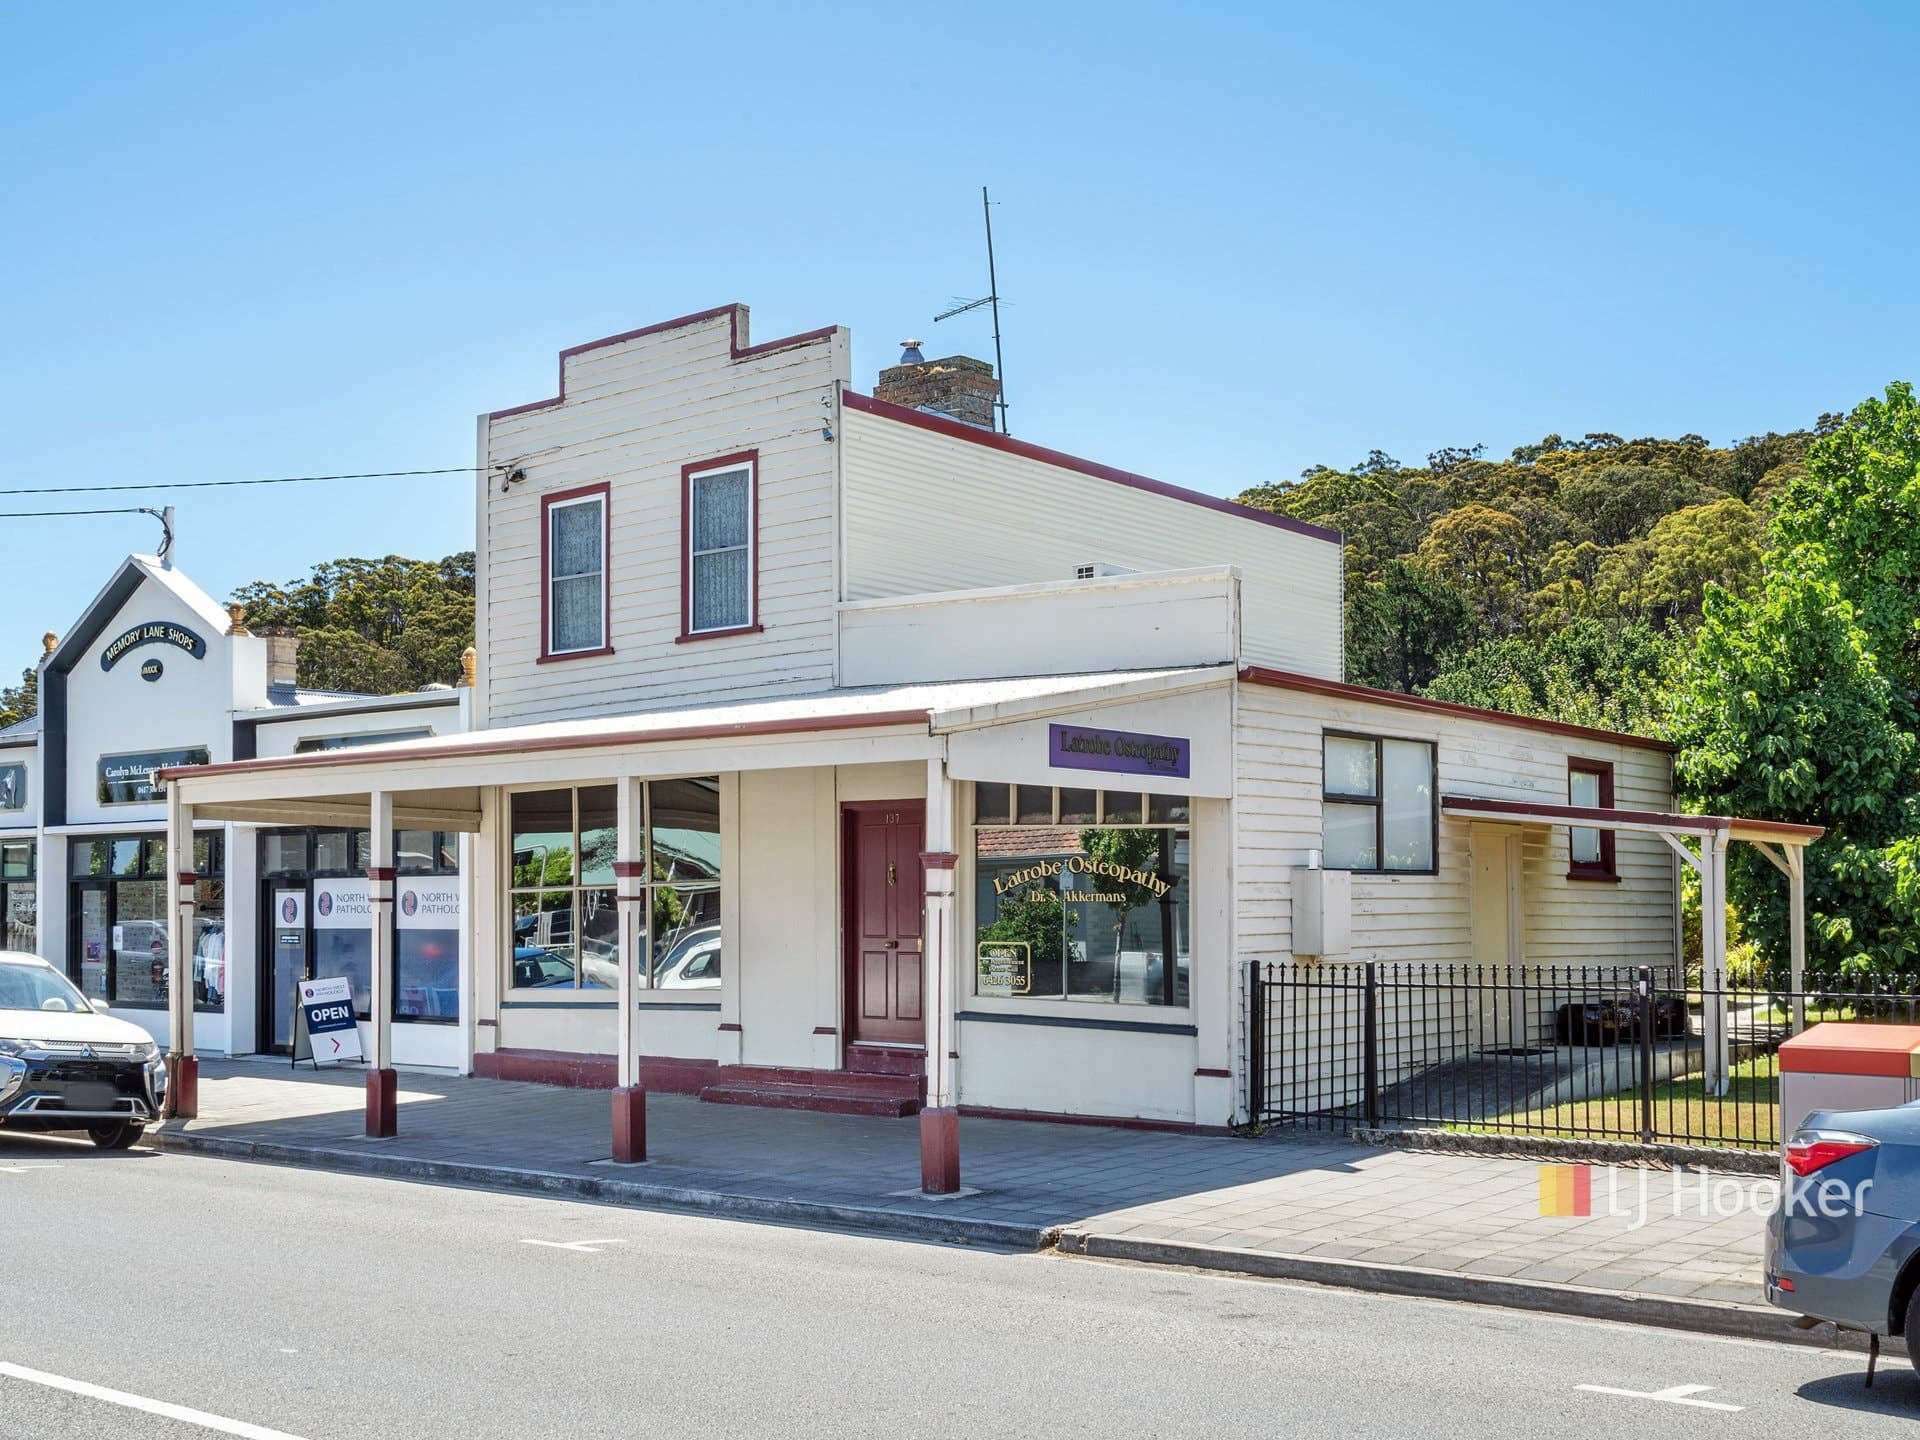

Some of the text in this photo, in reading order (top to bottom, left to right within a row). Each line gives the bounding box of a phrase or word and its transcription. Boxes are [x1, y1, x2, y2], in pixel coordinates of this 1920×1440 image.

[106, 626, 194, 661] MEMORY LANE SHOPS
[1060, 731, 1179, 766] Latrobe Osteopathy
[105, 765, 129, 779] Carolyn
[886, 813, 900, 824] 137
[993, 856, 1172, 898] Latrobe Osteopathy
[336, 894, 366, 903] NORTH
[421, 893, 454, 902] NORTH
[1031, 891, 1127, 902] Dr. S. Akkermans
[989, 949, 1017, 958] OPEN
[1005, 975, 1026, 986] 3055
[311, 1006, 349, 1022] OPEN
